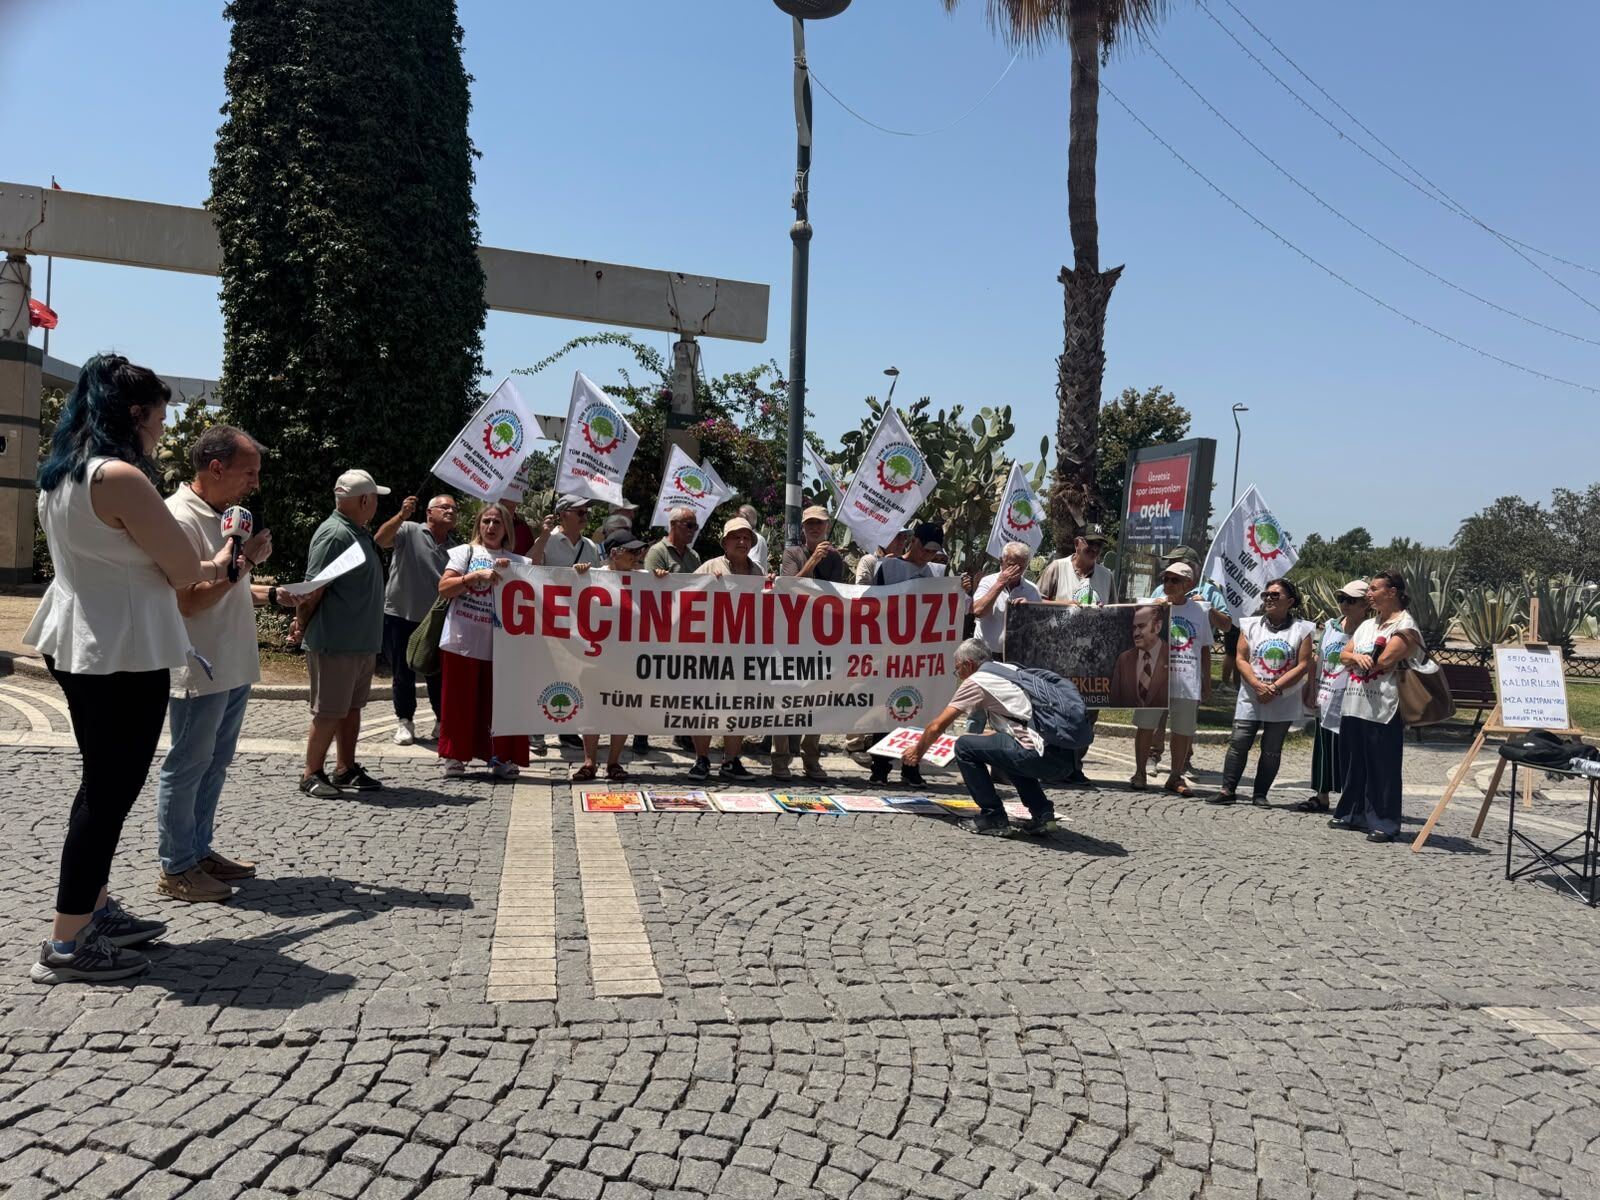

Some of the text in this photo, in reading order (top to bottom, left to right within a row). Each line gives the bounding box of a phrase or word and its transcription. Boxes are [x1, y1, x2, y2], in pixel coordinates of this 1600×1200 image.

[460, 438, 474, 452] TÜM
[472, 448, 505, 481] EMEKLİLERİN
[568, 448, 581, 456] TÜM
[451, 456, 473, 476] KONAK
[469, 473, 491, 491] ŞUBESİ
[464, 452, 493, 480] SENDİKASI
[1148, 471, 1171, 482] Ücretsiz
[858, 480, 906, 514] TÜM EMEKLİLERİN
[1135, 484, 1181, 498] spor istasyonları
[862, 492, 892, 514] SENDİKASI
[1140, 498, 1172, 522] açtık
[1238, 550, 1258, 572] TÜM
[501, 575, 959, 657] GEÇİNEMİYORUZ!
[636, 650, 945, 681] OTURMA EYLEMİ! 26. HAFTA
[1515, 665, 1539, 674] YASA
[1529, 655, 1554, 663] SAYILI
[1502, 679, 1560, 688] KALDIRILSIN
[599, 689, 643, 708] TÜM
[650, 691, 775, 711] EMEKLİLERİN
[781, 689, 874, 710] SENDİKASI
[664, 709, 813, 732] İZMİR ŞUBELERİ
